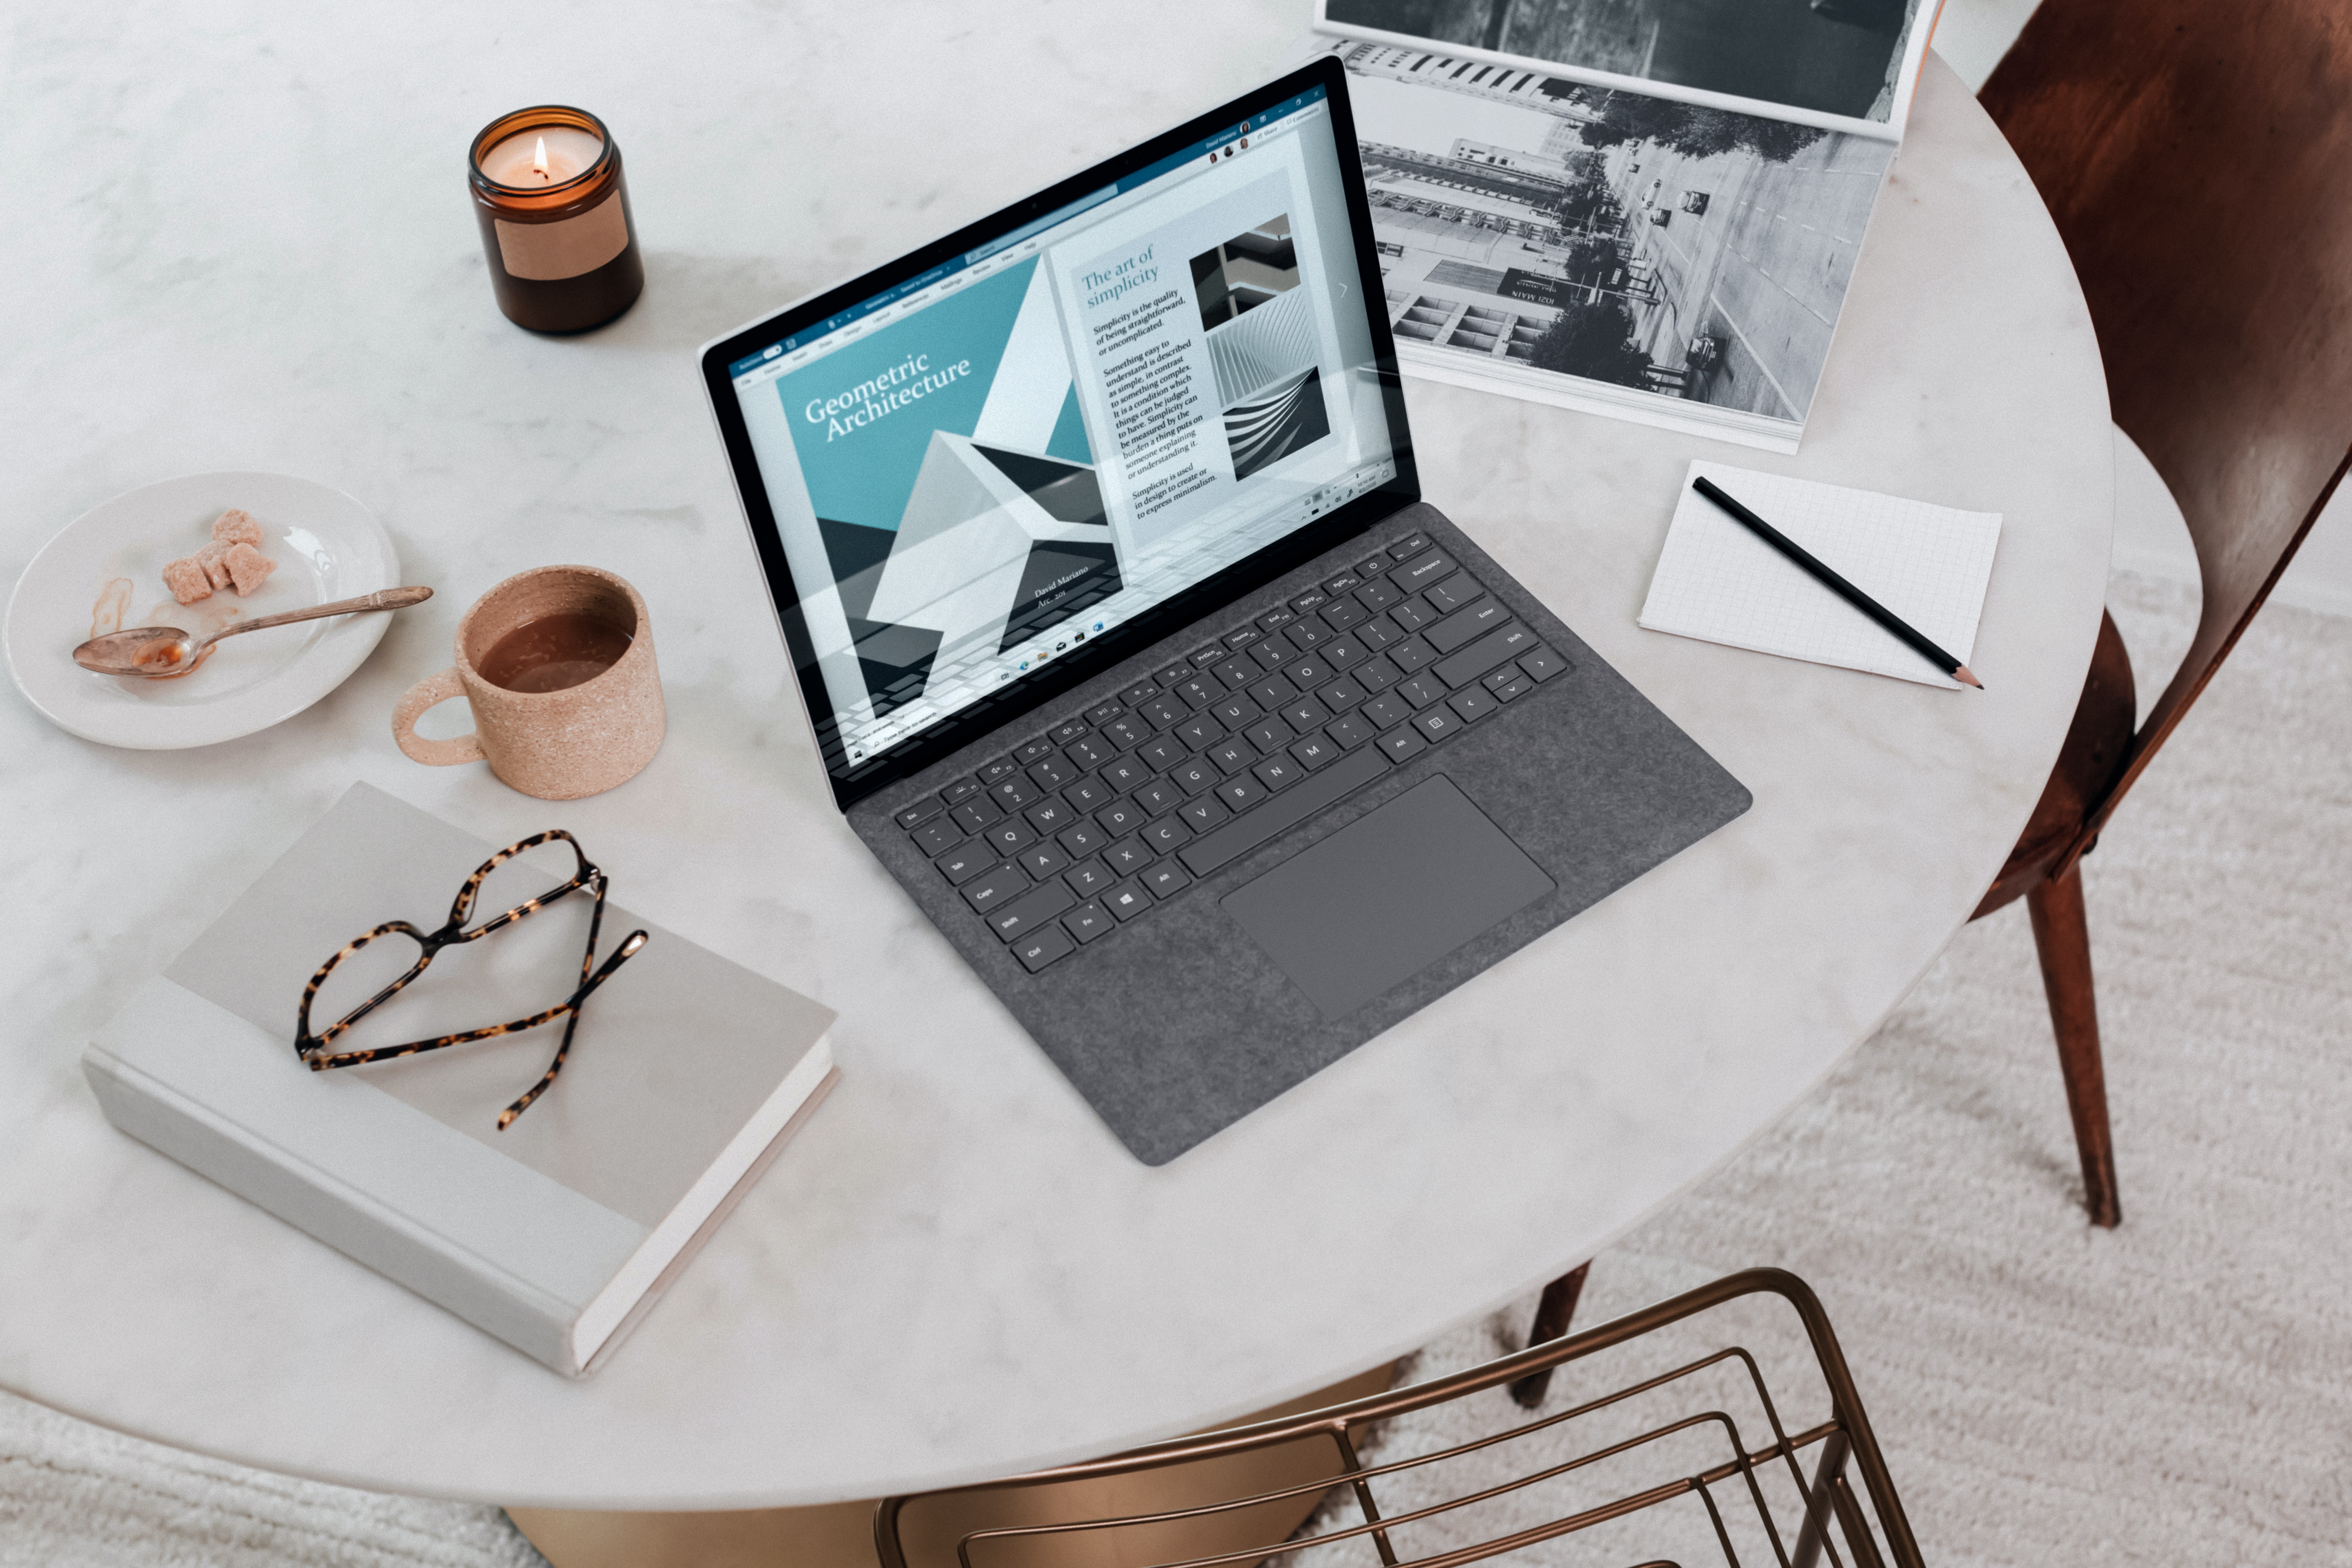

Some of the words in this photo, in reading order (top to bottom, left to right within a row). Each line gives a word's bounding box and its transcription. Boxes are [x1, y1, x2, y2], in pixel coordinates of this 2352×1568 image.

[1082, 270, 1111, 290] The
[1115, 257, 1135, 276] art
[1138, 243, 1153, 263] of
[1087, 266, 1158, 309] simplicity
[1512, 290, 1535, 301] MAIN
[1538, 296, 1555, 305] 1021
[1093, 312, 1130, 335] Simplicity
[1139, 302, 1152, 312] the
[1153, 289, 1178, 307] quality
[1096, 335, 1104, 345] of
[1105, 326, 1127, 341] being
[1127, 296, 1186, 330] straightforward,
[1098, 347, 1107, 356] or
[1108, 318, 1164, 352] uncomplicated.
[1103, 353, 1144, 377] Something
[1144, 345, 1160, 357] easy
[1160, 340, 1169, 349] to
[1106, 360, 1148, 388] understand
[1156, 339, 1192, 362] described
[1109, 390, 1117, 398] as
[1117, 377, 1144, 393] simple,
[1145, 371, 1154, 379] in
[1154, 355, 1184, 375] contrast
[805, 353, 929, 423] Geometric
[1110, 400, 1119, 408] to
[1120, 380, 1159, 404] something
[1159, 365, 1192, 384] complex.
[1134, 387, 1169, 408] condition
[1169, 374, 1192, 390] which
[827, 359, 971, 442] Architecture
[1116, 413, 1139, 429] things
[1140, 406, 1153, 416] can
[1153, 401, 1163, 410] be
[1164, 385, 1189, 406] judged
[1118, 431, 1127, 439] to
[1127, 421, 1146, 434] have.
[1147, 402, 1183, 424] Simplicity
[1184, 394, 1198, 405] can
[1120, 440, 1130, 449] be
[1131, 420, 1166, 444] measured
[1166, 417, 1176, 425] by
[1177, 410, 1189, 421] the
[1122, 442, 1149, 459] burden
[1155, 428, 1176, 443] thing
[1176, 420, 1193, 434] puts
[1193, 414, 1203, 423] on
[1125, 449, 1158, 470] someone
[1158, 429, 1196, 452] explaining
[1127, 471, 1136, 479] or
[1136, 444, 1189, 475] understanding
[1132, 477, 1168, 500] Simplicity
[1176, 462, 1194, 477] used
[1134, 501, 1143, 510] in
[1143, 489, 1167, 505] design
[1167, 484, 1176, 492] to
[1176, 473, 1198, 488] create
[1198, 468, 1207, 476] or
[1137, 511, 1145, 520] to
[1145, 497, 1172, 515] express
[1173, 475, 1217, 501] minimalism.
[1412, 560, 1441, 576] Backspace
[1034, 581, 1056, 598] David
[1057, 566, 1088, 586] Mariano
[1333, 579, 1348, 588] PgDn
[1300, 597, 1315, 606] PgUp
[1478, 608, 1494, 618] Enter
[1268, 615, 1280, 623] End
[1232, 632, 1249, 642] Home
[1507, 633, 1522, 643] Shift
[1197, 650, 1215, 661] PrtScn
[1337, 648, 1345, 657] P
[1302, 668, 1312, 676] O
[1229, 707, 1240, 716] U
[1299, 710, 1310, 719] K
[884, 733, 898, 742] Type
[898, 726, 911, 735] here
[918, 712, 937, 724] search
[1225, 751, 1237, 760] H
[1306, 746, 1319, 756] M
[1119, 769, 1129, 777] R
[1190, 771, 1200, 780] G
[1271, 767, 1283, 776] N
[1081, 790, 1091, 798] E
[1153, 792, 1160, 800] F
[1235, 788, 1245, 797] B
[1041, 809, 1054, 820] W
[1114, 813, 1124, 822] D
[1196, 808, 1206, 817] V
[1005, 832, 1016, 841] Q
[1077, 834, 1086, 843] S
[1160, 829, 1171, 838] C
[1039, 856, 1049, 865] A
[1121, 851, 1133, 861] X
[1083, 872, 1094, 882] Z
[1159, 873, 1169, 882] Alt
[976, 889, 993, 899] Caps
[1002, 917, 1018, 928] Shift
